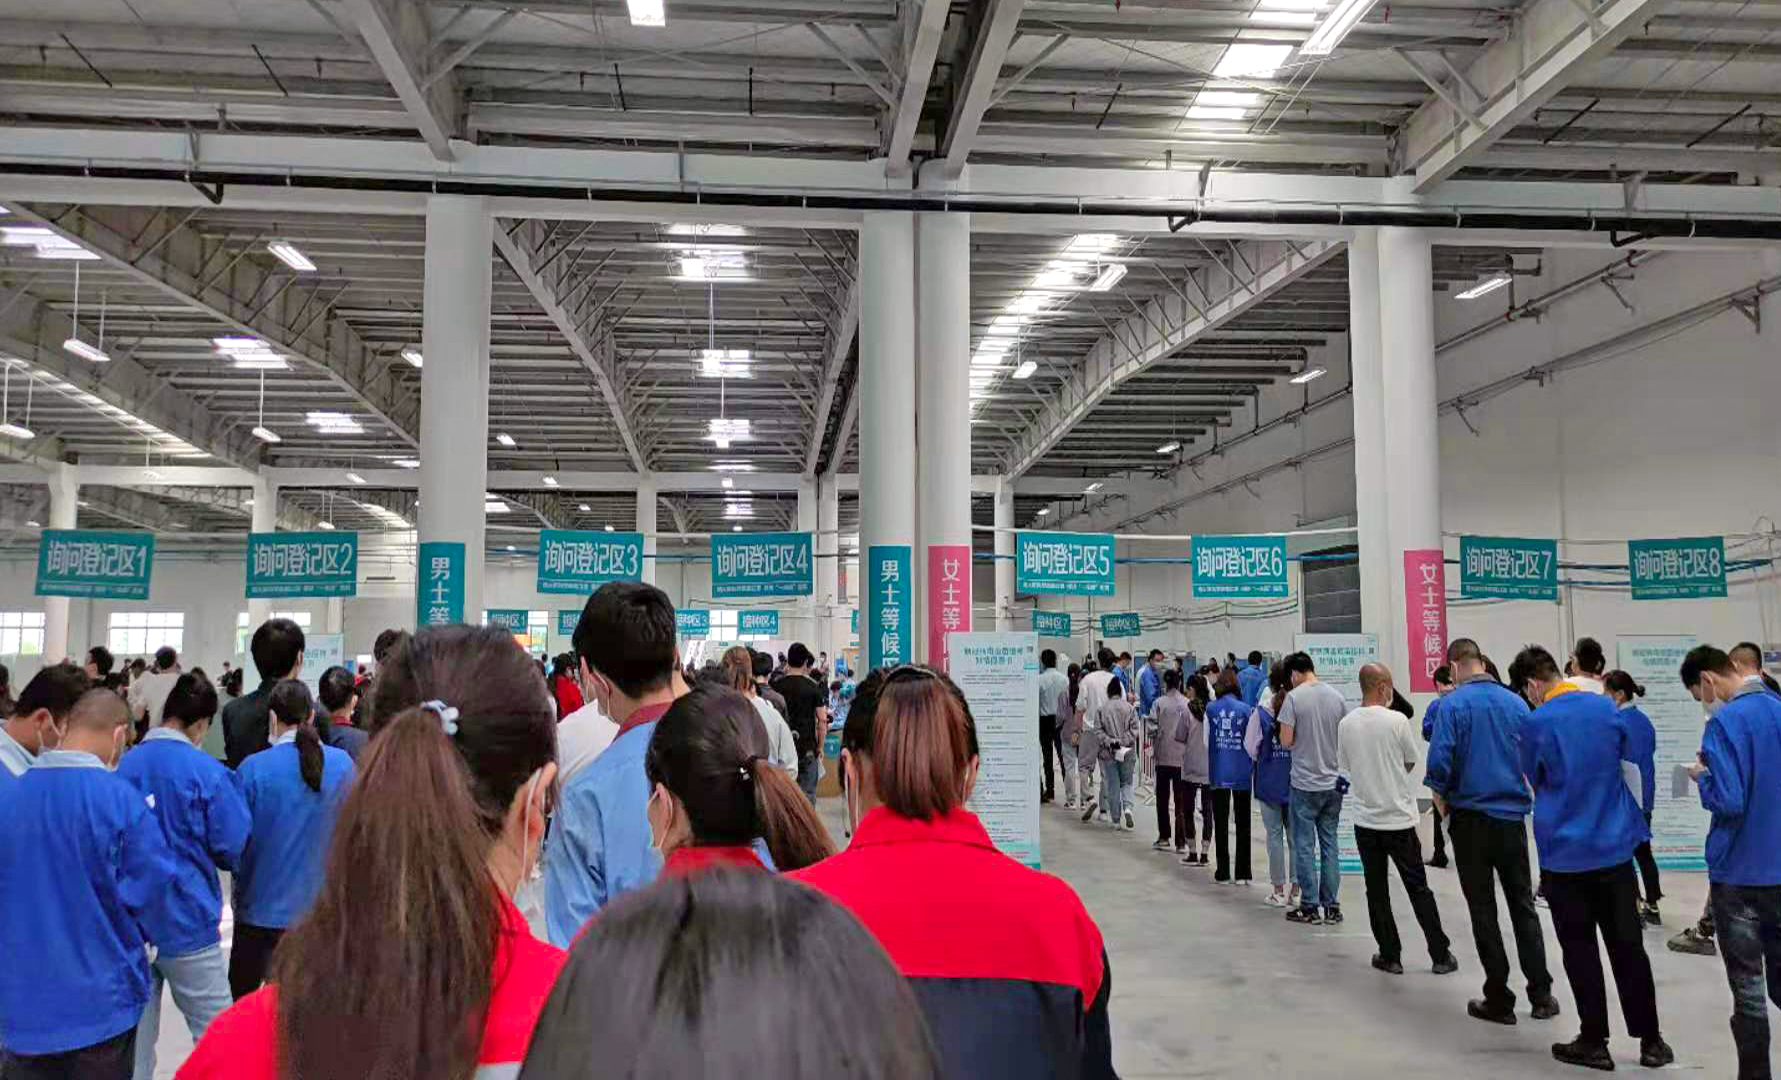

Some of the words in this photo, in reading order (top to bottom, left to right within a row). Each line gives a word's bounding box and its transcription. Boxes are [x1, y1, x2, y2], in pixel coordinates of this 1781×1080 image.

[47, 539, 147, 578] 询问登记区1
[253, 541, 353, 578] 询问登记区2
[544, 540, 639, 576] 询问登记区3
[717, 543, 809, 577] 询问登记区4
[1022, 541, 1110, 577] 询问登记区5
[1196, 546, 1283, 578] 询问登记区6
[1465, 548, 1553, 580] 询问登记区7
[1633, 547, 1722, 580] 询问登记区8
[1418, 562, 1442, 679] 女士等候区
